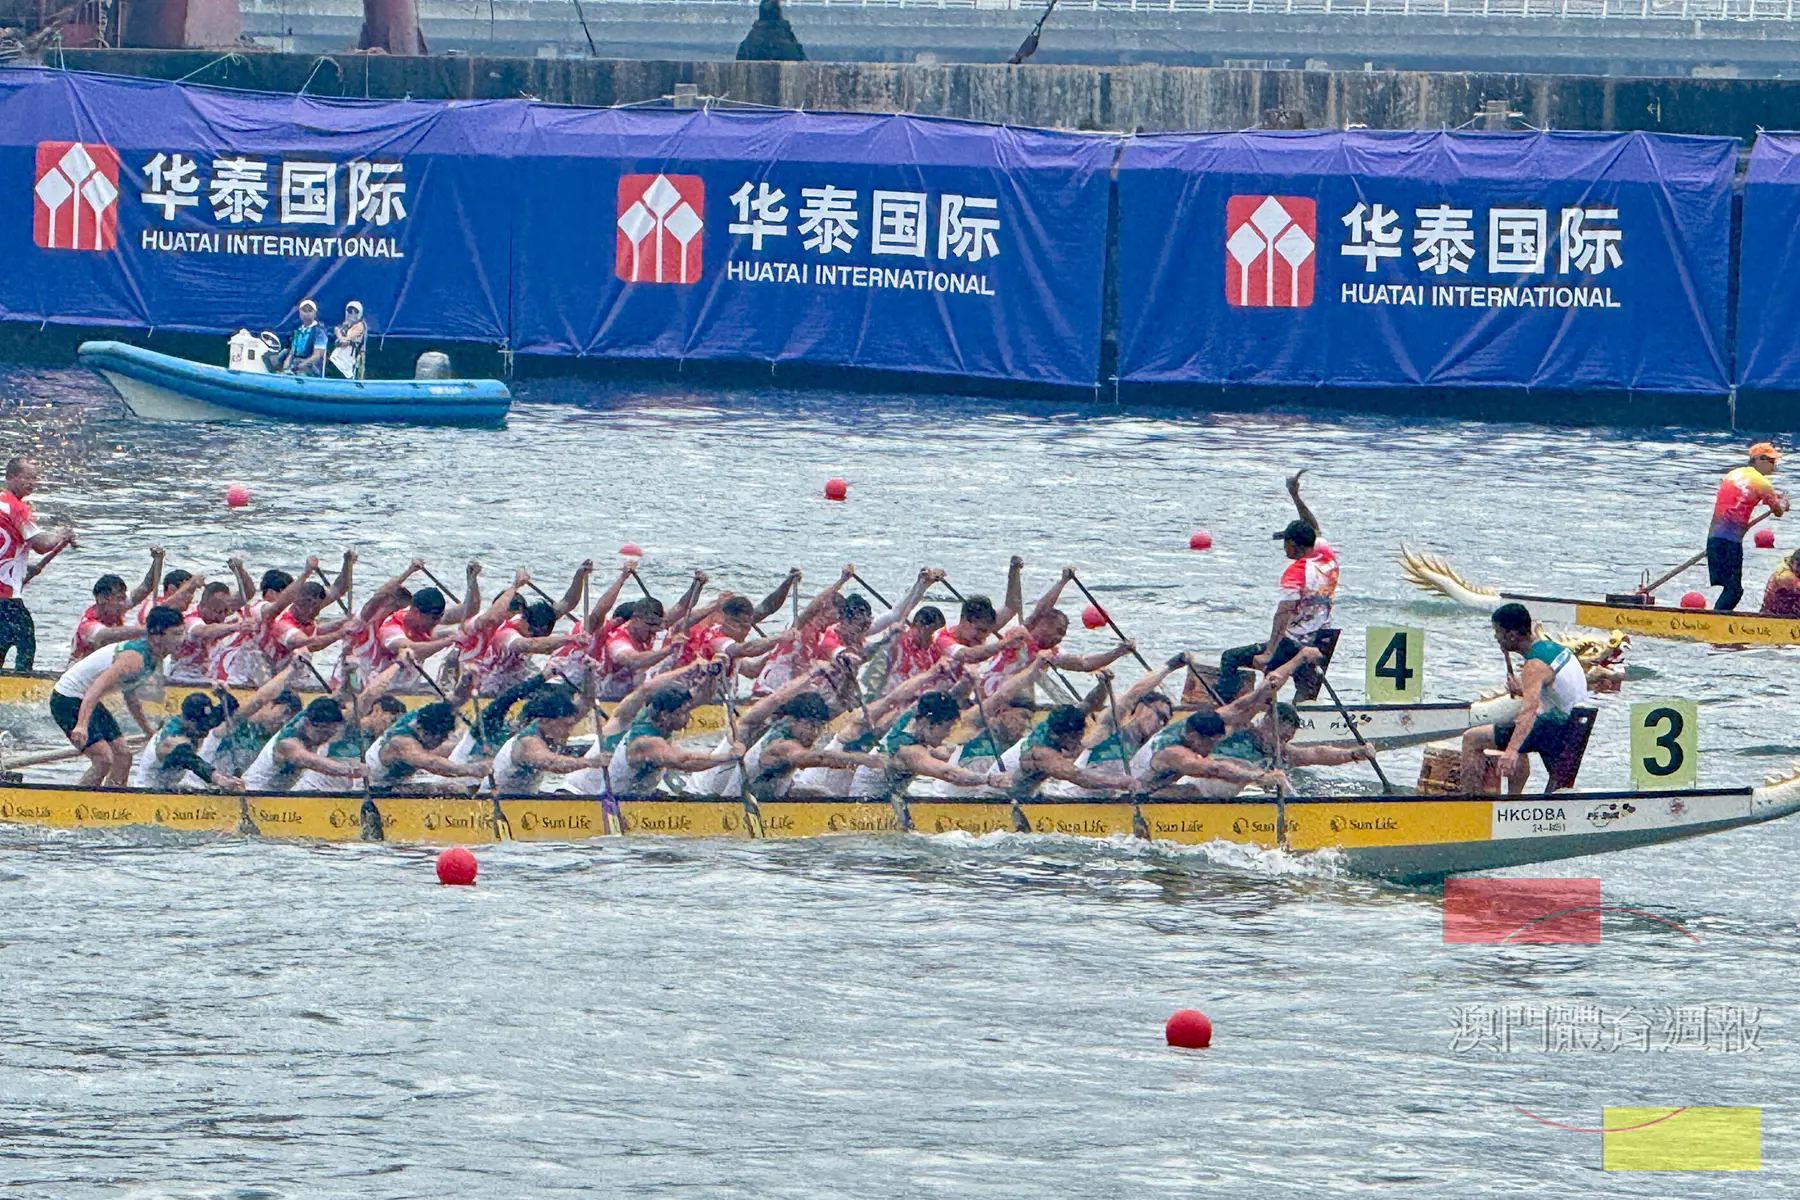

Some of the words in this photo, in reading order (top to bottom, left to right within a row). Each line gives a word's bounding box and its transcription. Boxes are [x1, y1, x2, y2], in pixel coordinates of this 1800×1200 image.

[141, 152, 407, 226] 华泰国际
[142, 229, 219, 254] HUATAI
[227, 234, 404, 258] INTERNATIONAL
[728, 181, 1000, 262] 华泰国际
[1341, 201, 1623, 275] 华泰国际
[727, 260, 808, 284] HUATAI
[815, 264, 995, 296] INTERNATIONAL
[1341, 283, 1424, 305] HUATAI
[1432, 286, 1621, 308] INTERNATIONAL
[1375, 632, 1413, 691] 4
[1643, 707, 1684, 776] 3
[1349, 818, 1373, 831] Sun
[1375, 816, 1399, 830] Life
[1497, 807, 1567, 823] HKCDBA
